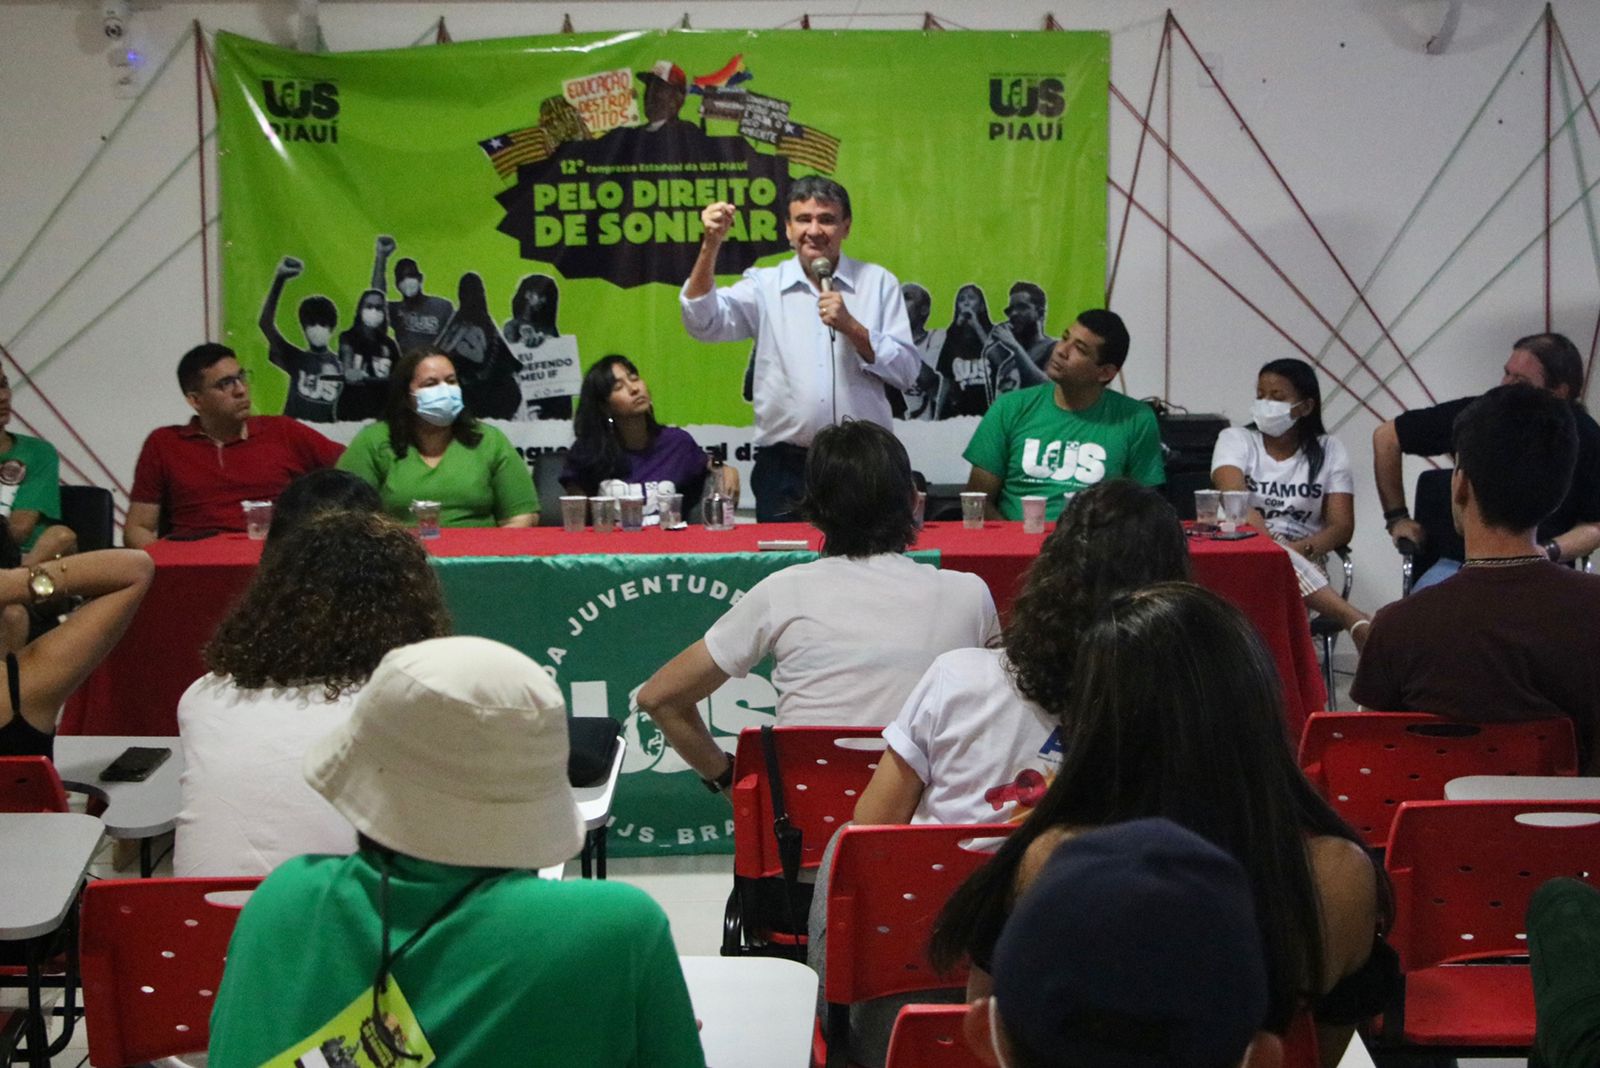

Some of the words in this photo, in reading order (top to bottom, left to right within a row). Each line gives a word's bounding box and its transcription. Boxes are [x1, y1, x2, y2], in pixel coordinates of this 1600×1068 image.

[989, 78, 1066, 118] UJS
[989, 118, 1063, 141] PIAUÍ
[639, 162, 682, 172] Estadual
[684, 162, 698, 172] da
[533, 181, 624, 213] PELO
[632, 177, 777, 208] DIREITO
[535, 213, 588, 248] DE
[520, 370, 546, 381] MEU
[1021, 437, 1107, 485] UJS
[1264, 498, 1285, 508] COM
